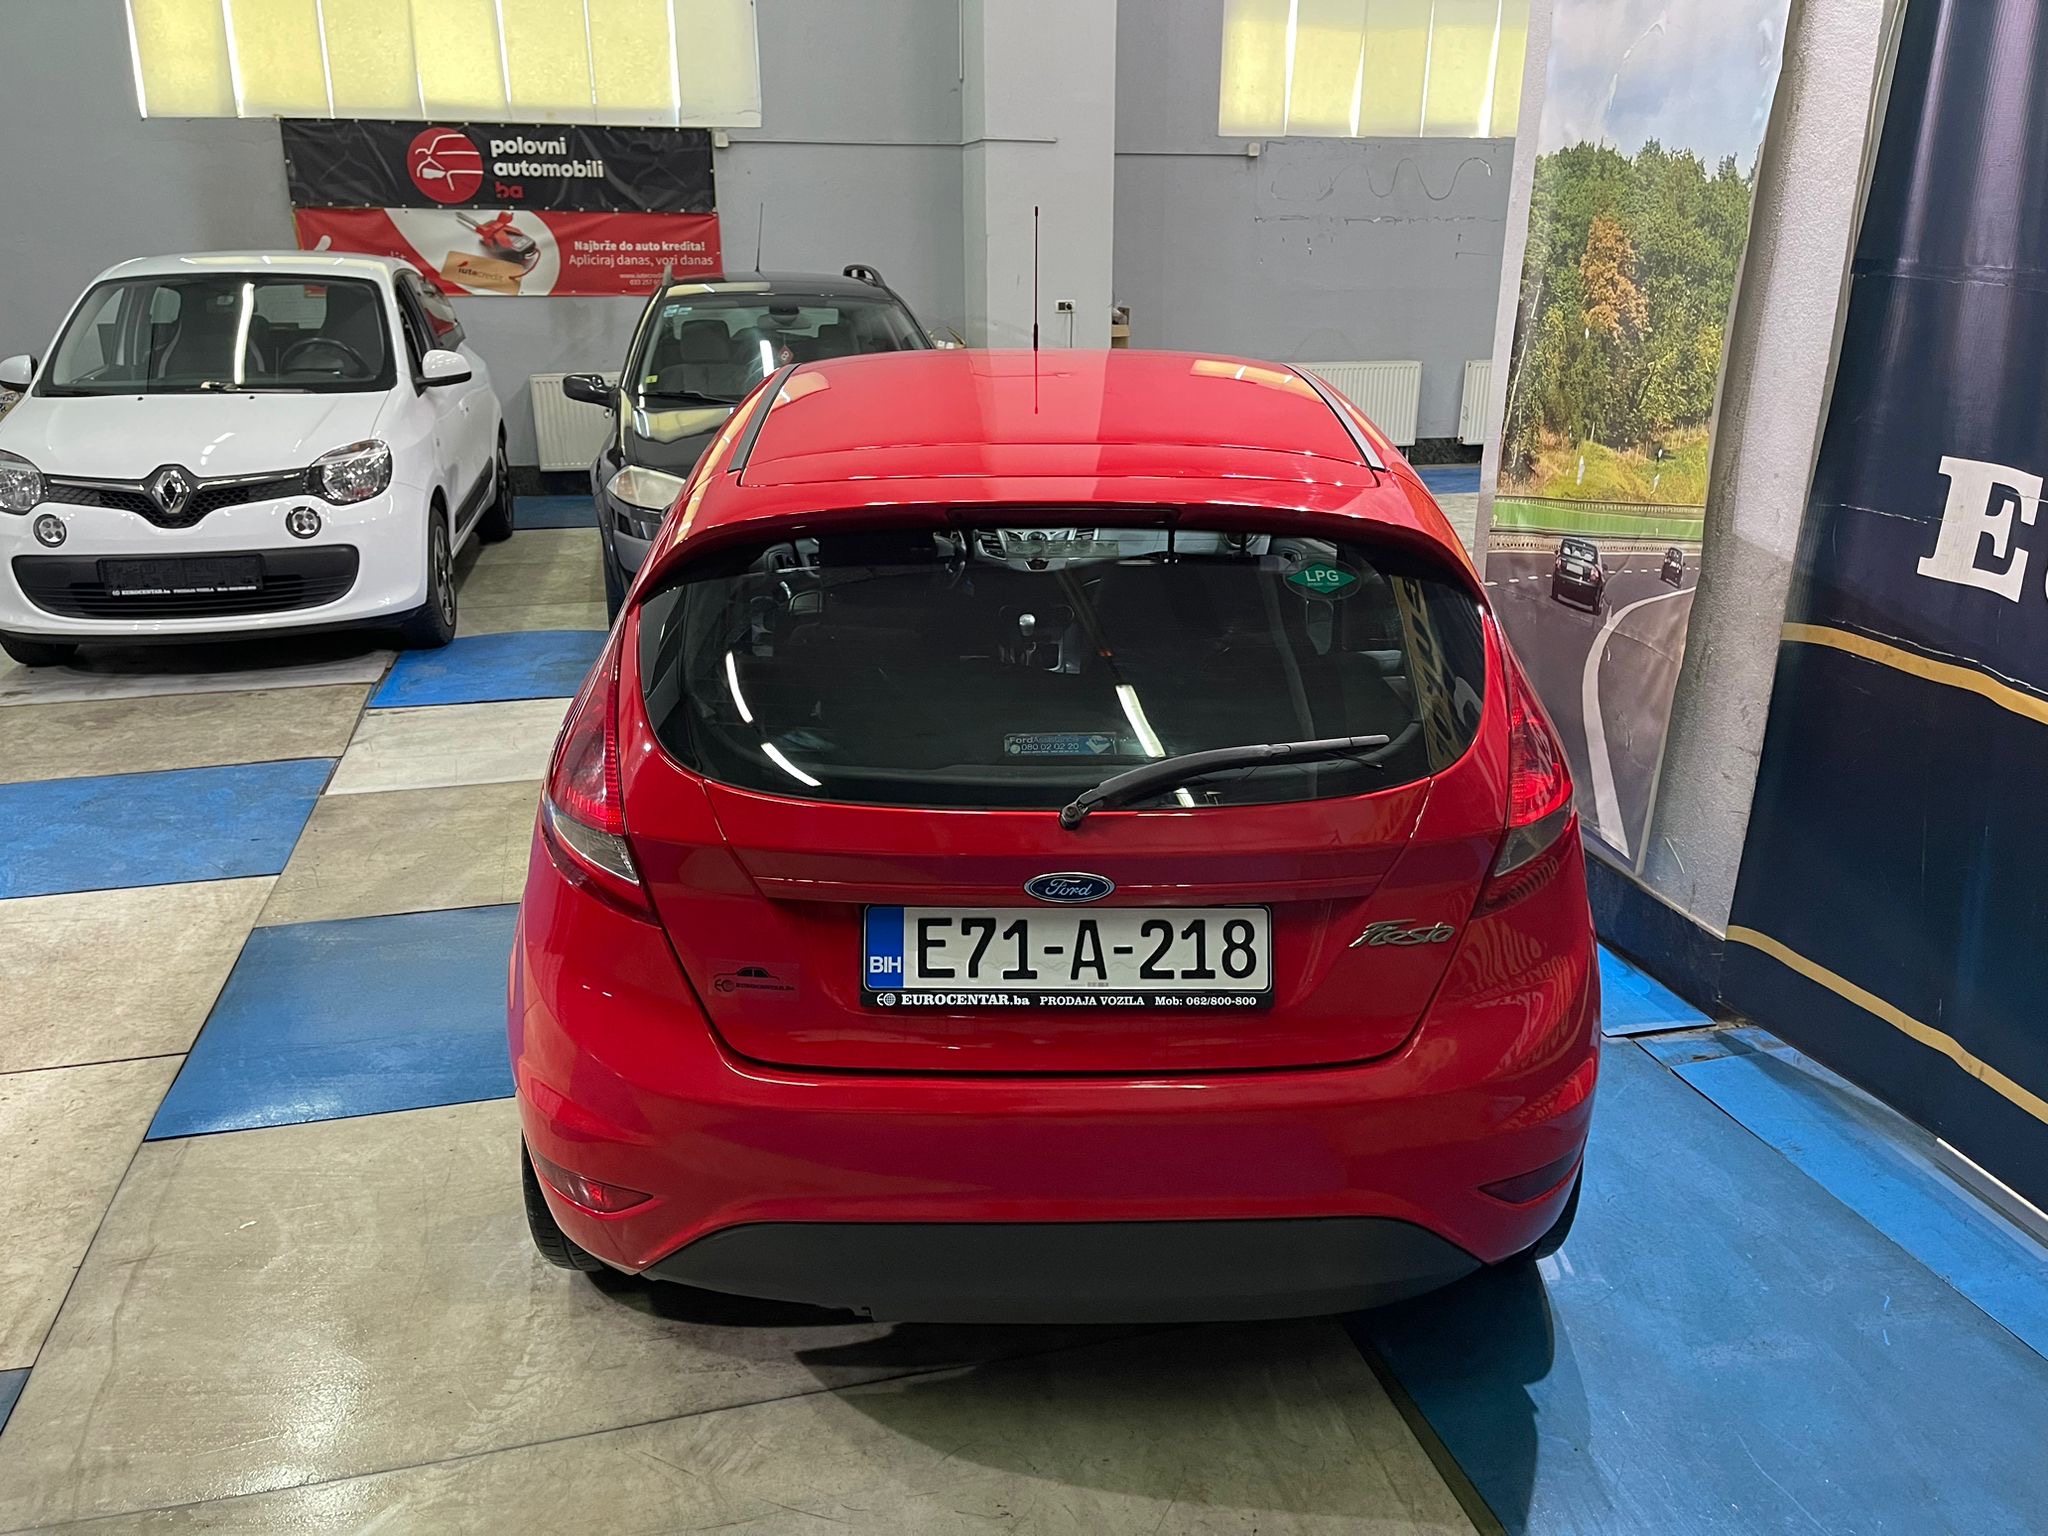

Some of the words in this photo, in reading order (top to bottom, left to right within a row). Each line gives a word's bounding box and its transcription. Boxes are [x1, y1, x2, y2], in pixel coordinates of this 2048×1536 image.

[490, 136, 567, 158] polovni
[493, 160, 604, 178] automobili
[574, 240, 617, 253] Najbrže
[619, 240, 633, 251] do
[635, 241, 660, 251] auto
[661, 241, 705, 251] kredita!
[569, 254, 615, 268] Apliciraj
[616, 255, 654, 267] danas,
[656, 255, 678, 265] vozi
[680, 255, 714, 266] danas
[1916, 455, 2048, 604] E
[1305, 569, 1339, 582] LPG
[1021, 743, 1038, 751] 080
[1053, 742, 1065, 750] 02
[1067, 742, 1079, 750] 20
[1045, 878, 1093, 896] Ford
[1348, 918, 1455, 948] Fiesta
[868, 955, 902, 973] BIH
[916, 916, 1257, 980] E71-A-218
[901, 993, 1030, 1006] EUROCENTAR.ba
[1039, 996, 1097, 1006] PRODAJA
[1099, 996, 1145, 1006] VOZILA
[1155, 996, 1183, 1006] Mob:
[1186, 996, 1257, 1006] 062/800-800
